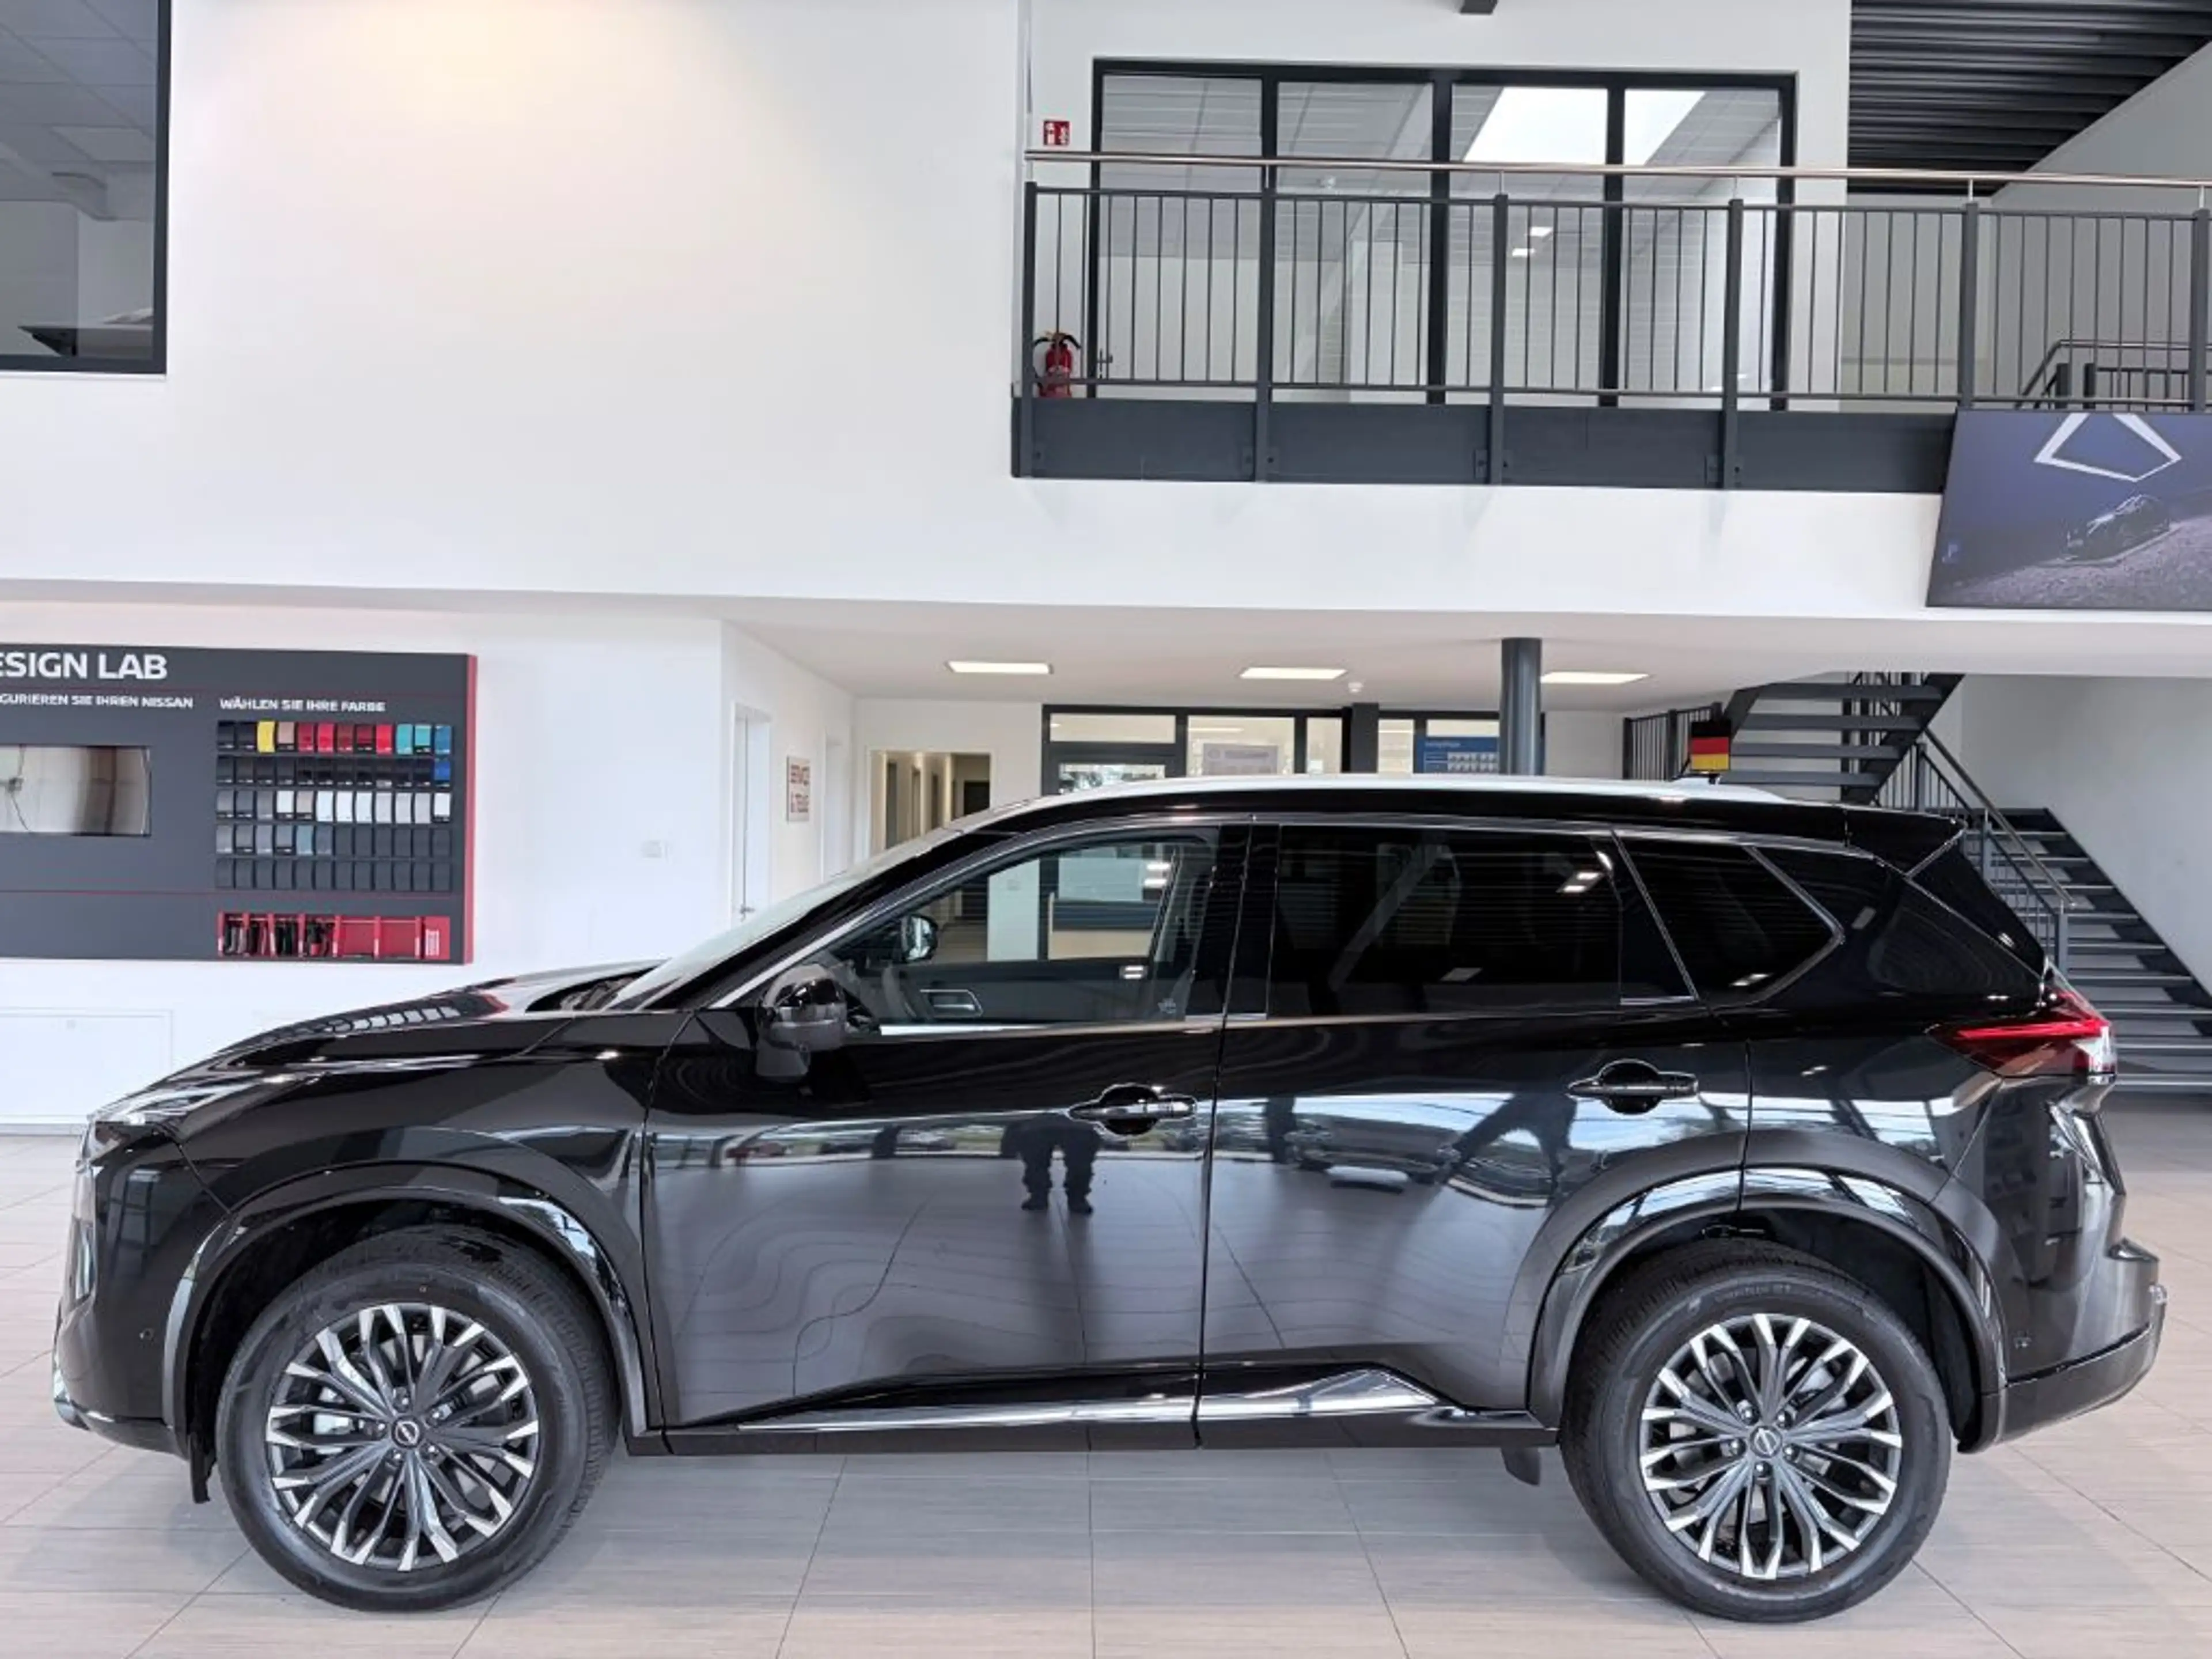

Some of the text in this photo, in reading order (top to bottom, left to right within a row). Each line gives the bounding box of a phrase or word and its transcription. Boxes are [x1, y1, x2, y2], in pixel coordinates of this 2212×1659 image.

[0, 652, 168, 680] SIGN LAB
[71, 695, 93, 706] SIE
[97, 695, 139, 707] IHREN
[142, 697, 194, 709] NISSAN
[219, 695, 387, 713] WÄHLEN SIE IHRE FARBE
